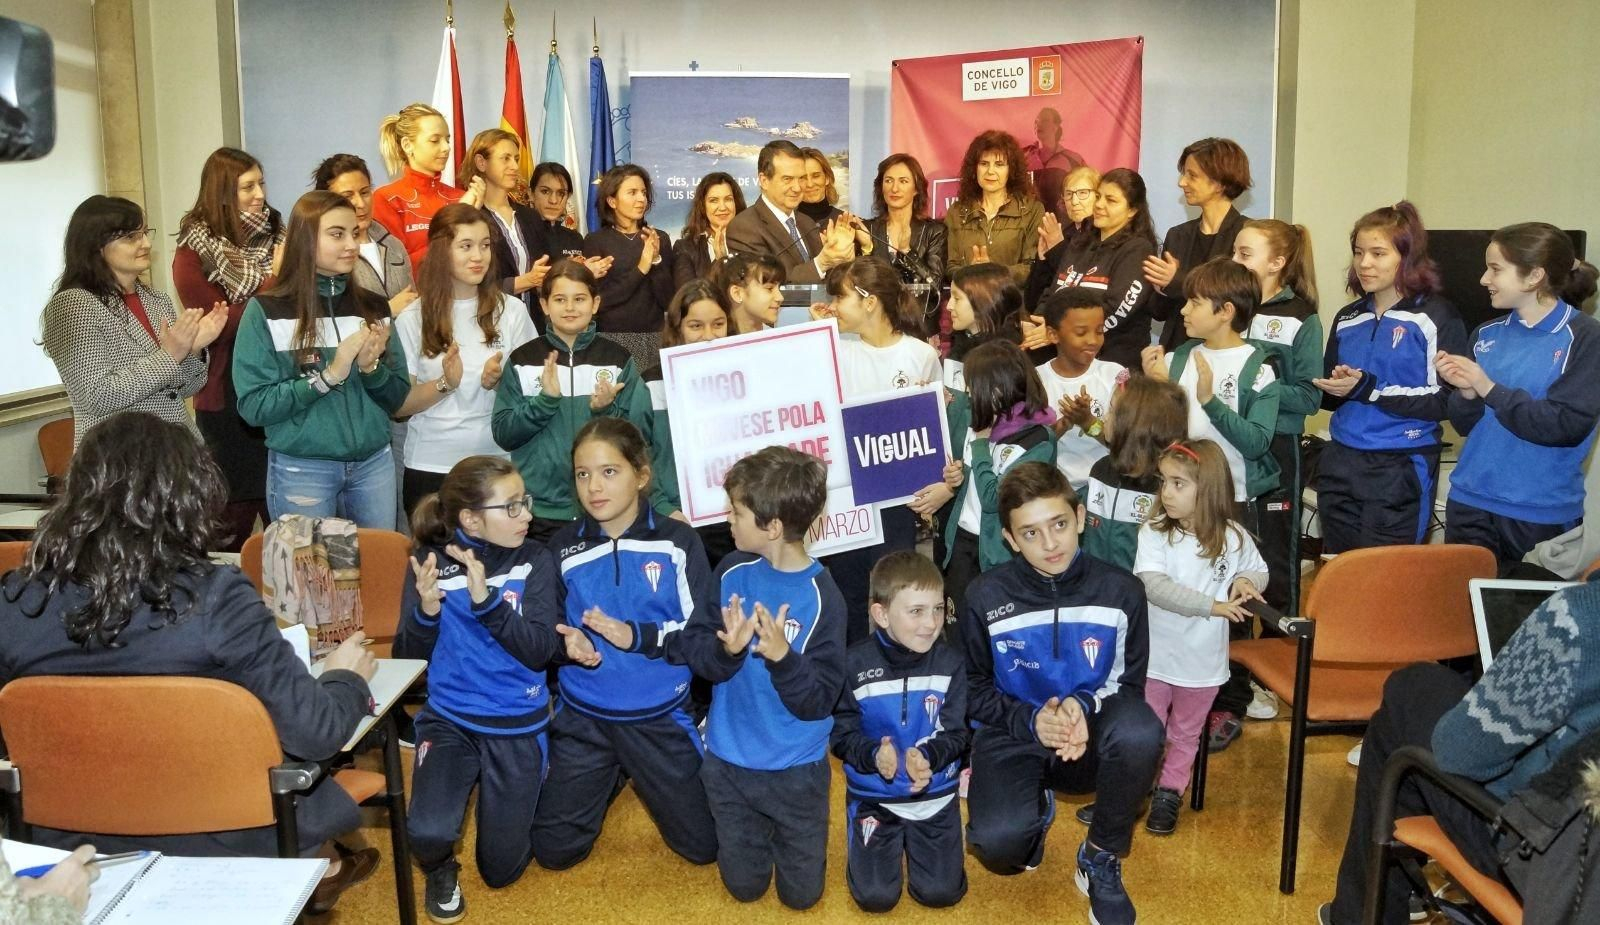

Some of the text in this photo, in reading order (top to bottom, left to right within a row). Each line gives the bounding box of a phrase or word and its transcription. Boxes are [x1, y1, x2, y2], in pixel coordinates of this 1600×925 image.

[967, 66, 1024, 80] CONCELLO
[974, 80, 1018, 91] DE VIGO
[667, 176, 689, 188] CÍES,
[739, 177, 750, 186] DE
[667, 190, 684, 200] TUS
[1115, 280, 1143, 318] VIGO
[691, 370, 747, 401] VIGO
[778, 401, 825, 431] POLA
[853, 427, 937, 468] VIGUAL
[808, 508, 871, 543] MARZO
[987, 602, 1015, 621] ZICO
[857, 667, 884, 682] ZICO
